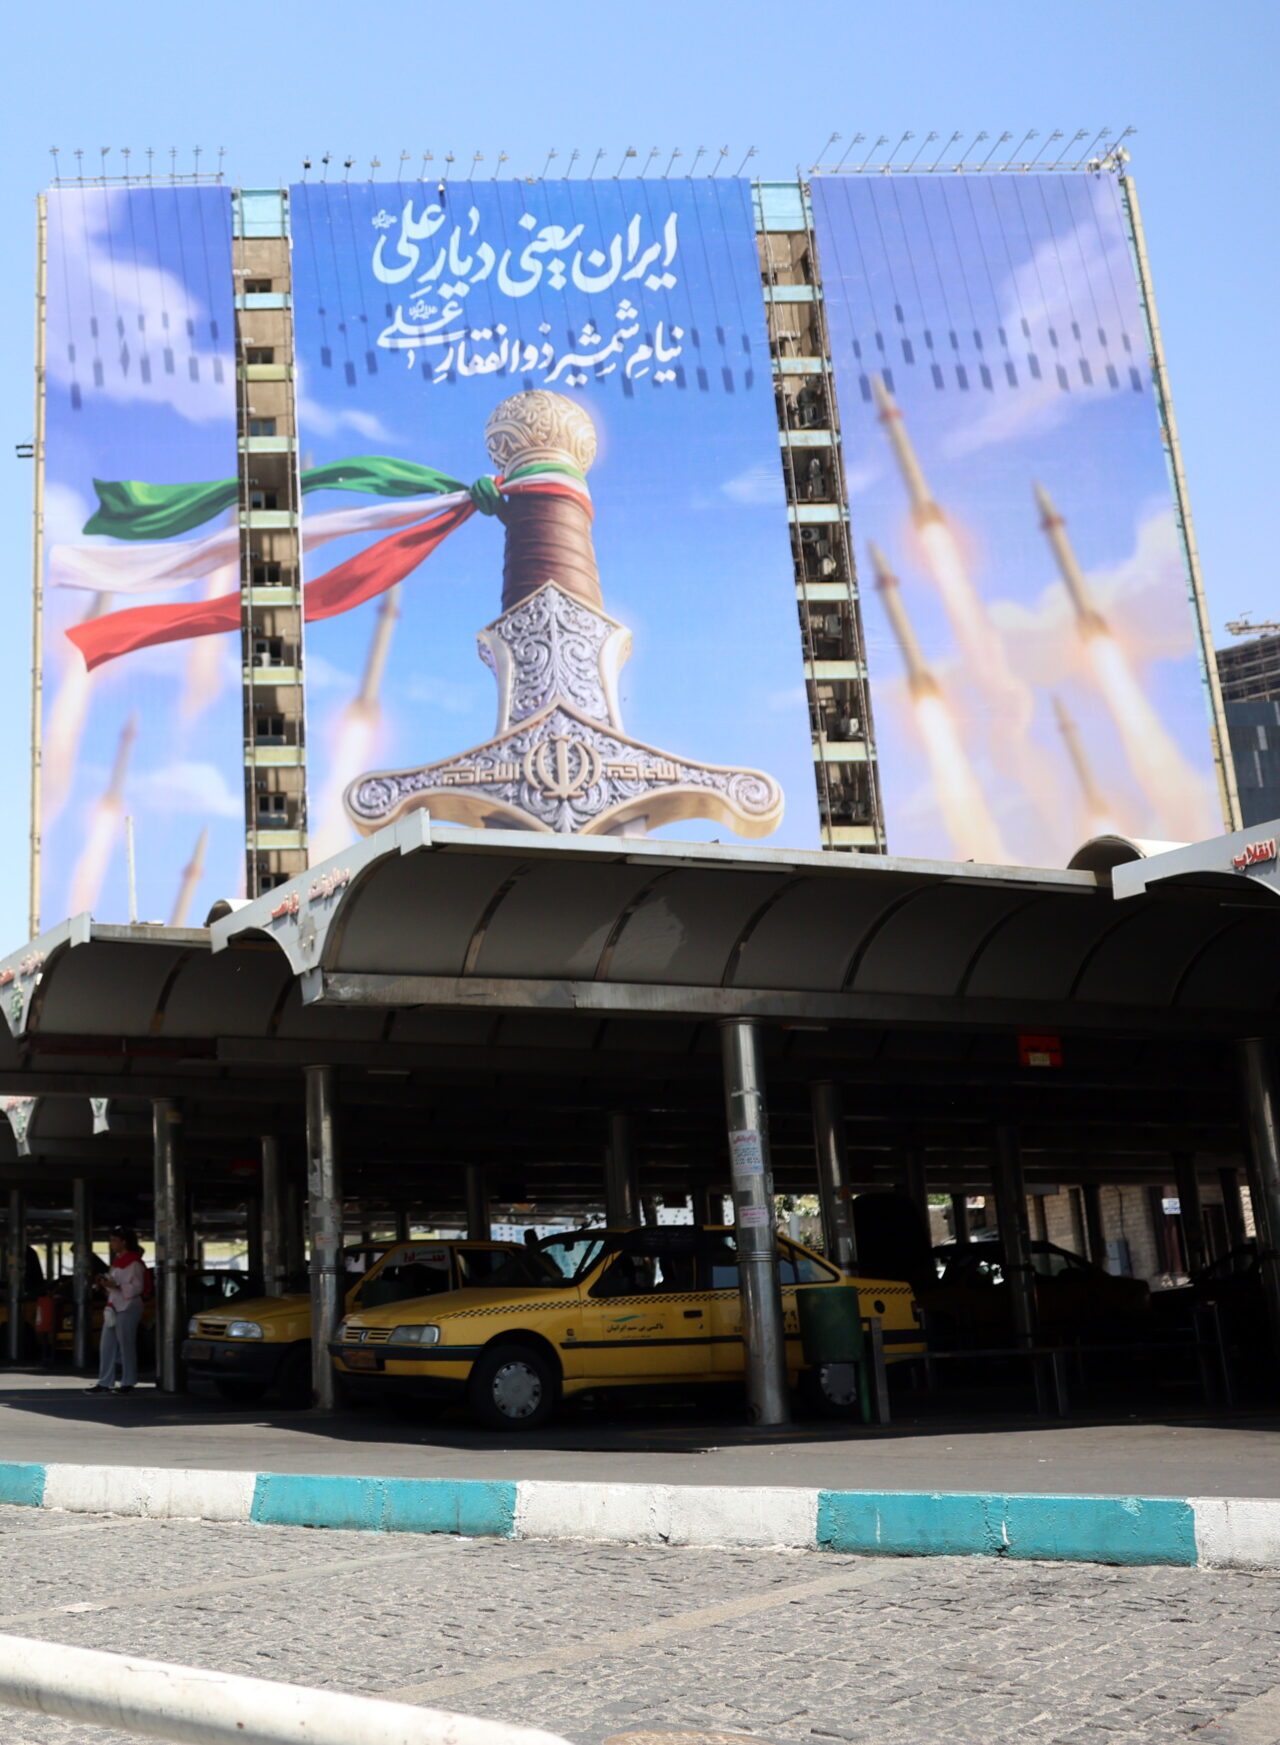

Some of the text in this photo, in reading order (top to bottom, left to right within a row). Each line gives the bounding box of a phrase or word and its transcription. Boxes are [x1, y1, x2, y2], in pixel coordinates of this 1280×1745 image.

[497, 212, 585, 297] یعنی
[571, 212, 678, 294] ایران
[1232, 838, 1276, 872] انقلاب
